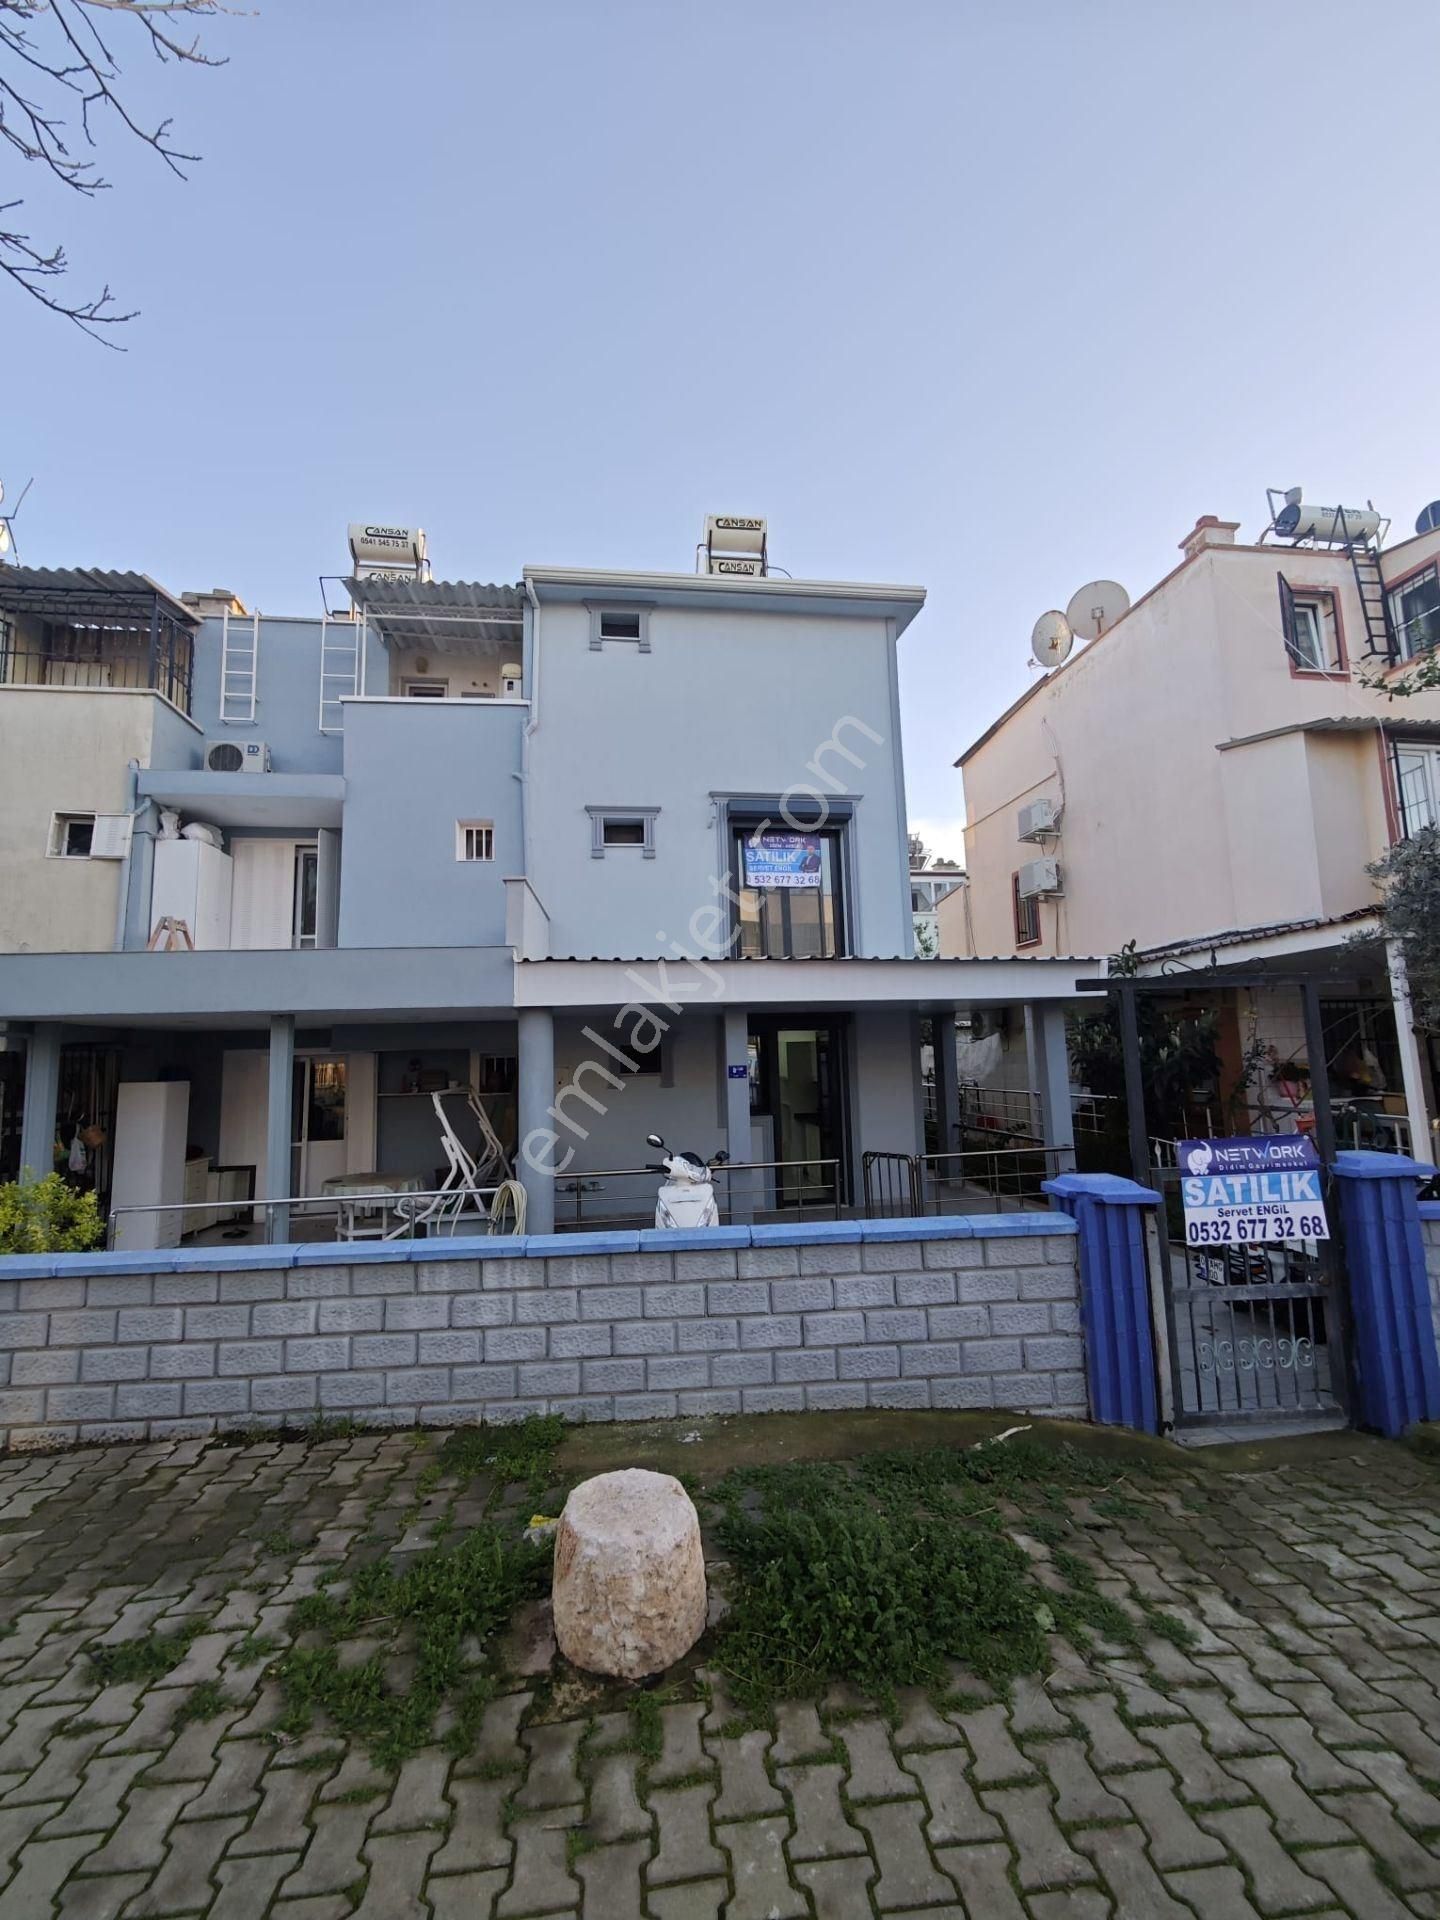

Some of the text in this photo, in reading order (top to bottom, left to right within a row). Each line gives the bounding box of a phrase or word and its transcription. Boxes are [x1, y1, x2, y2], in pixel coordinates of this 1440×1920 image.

[716, 518, 763, 530] CANSAN
[365, 527, 409, 540] CANSAN
[719, 562, 755, 575] CANSAN
[746, 850, 796, 862] SATILIK
[754, 875, 771, 884] 532
[774, 875, 791, 884] 677
[794, 876, 806, 885] 32
[808, 875, 820, 884] 68
[1215, 1141, 1306, 1162] NETWORK
[1219, 1160, 1308, 1171] Didim Gayrimenkul
[1185, 1172, 1318, 1207] SATILIK
[1217, 1206, 1252, 1218] Servet
[1189, 1215, 1324, 1242] 0532 677 32 68
